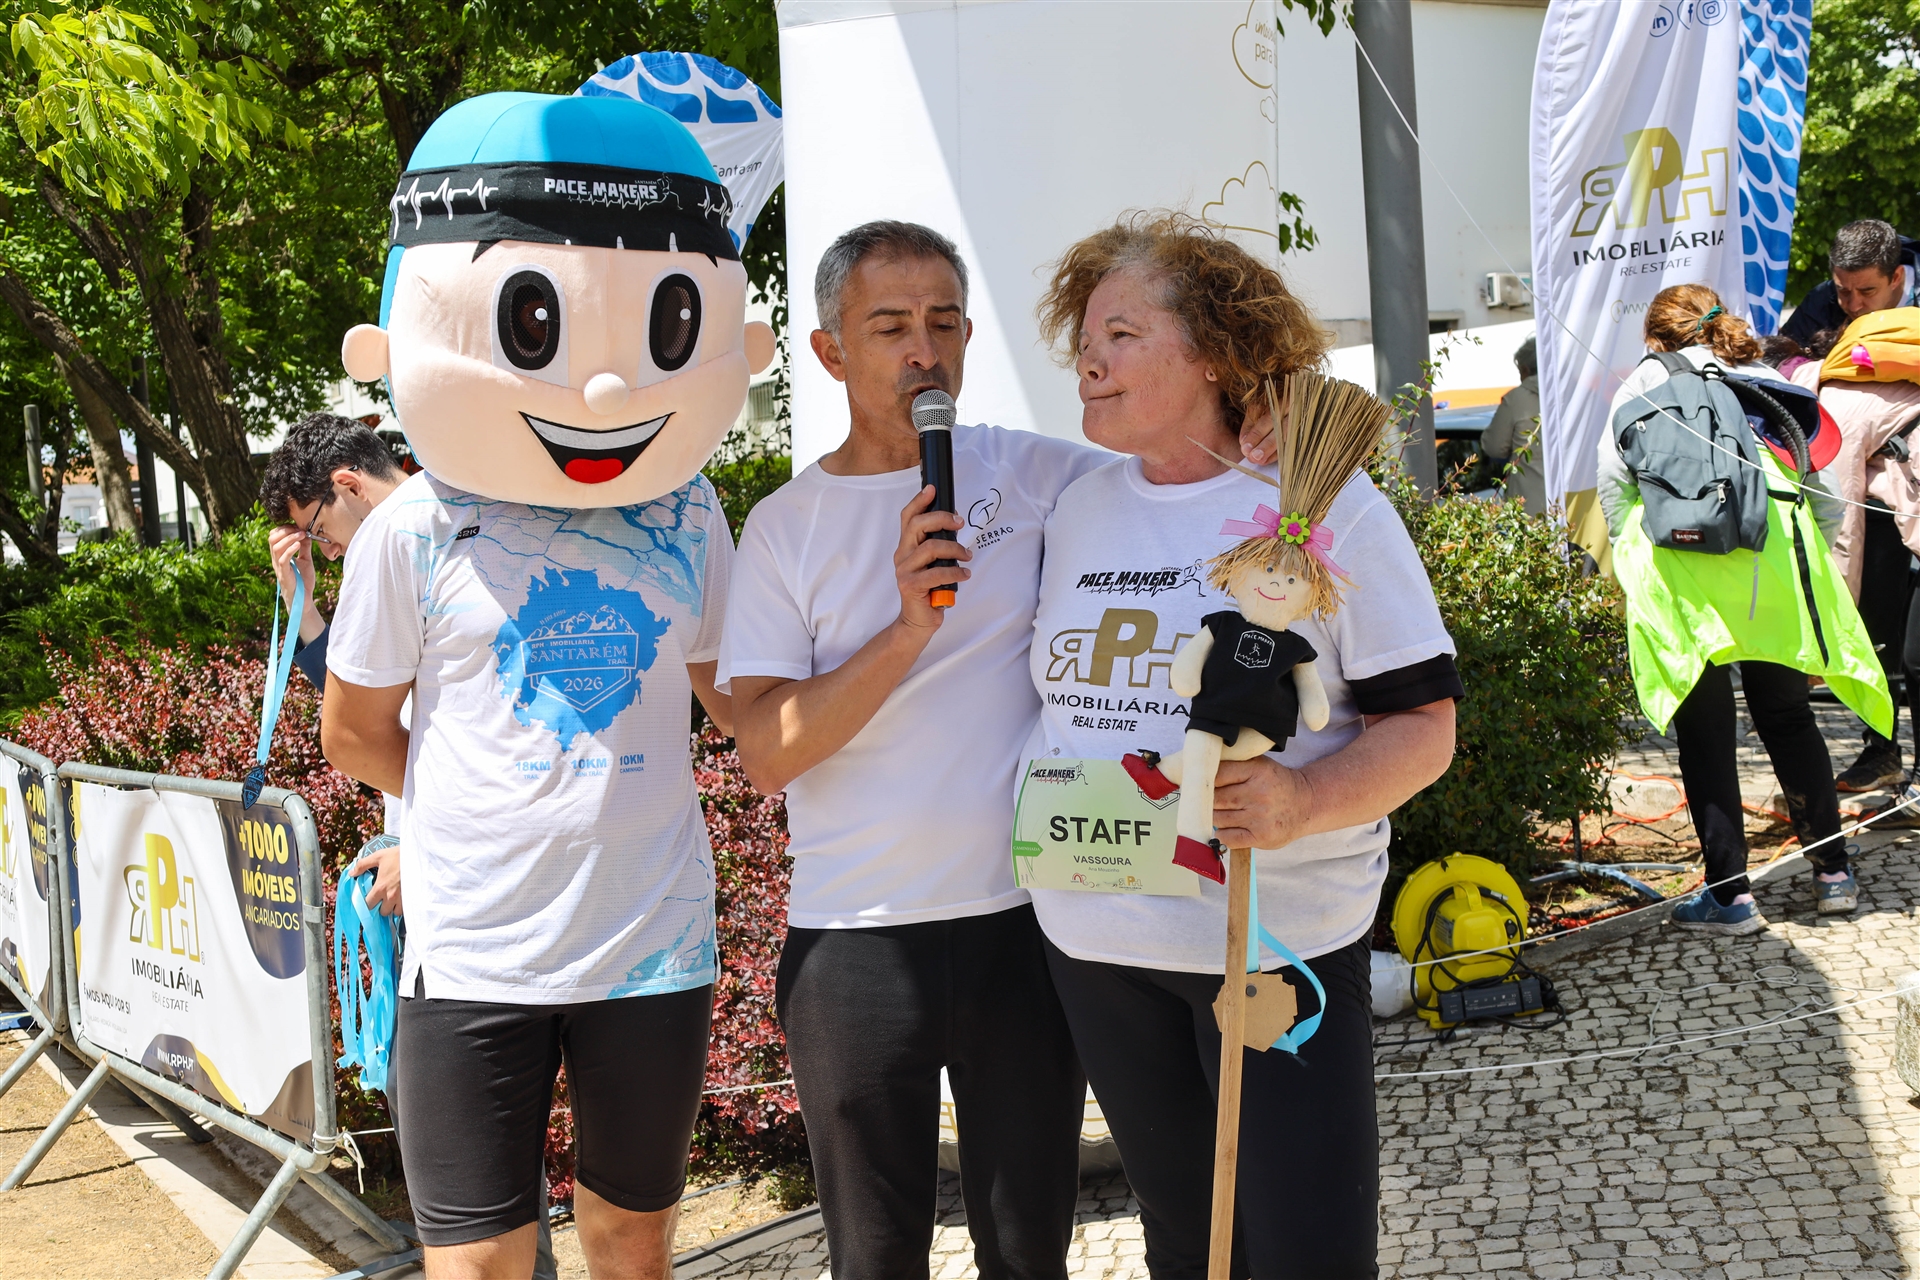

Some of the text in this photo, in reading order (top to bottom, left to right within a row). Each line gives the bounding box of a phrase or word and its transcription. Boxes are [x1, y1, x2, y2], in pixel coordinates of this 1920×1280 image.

[544, 178, 658, 200] PACE MAKERS
[1641, 257, 1692, 274] ESTATE
[1076, 571, 1181, 588] PACE MAKERS
[530, 643, 628, 663] SANTARÉM
[563, 677, 604, 692] 2026
[1047, 693, 1190, 717] IMOBILIÁRIA
[1072, 715, 1138, 732] REAL ESTATE
[515, 760, 551, 771] 18KM
[571, 758, 607, 769] 10KM
[619, 754, 645, 765] 10KM
[1048, 769, 1075, 778] MAKERS
[1050, 815, 1151, 845] STAFF
[239, 820, 289, 865] +1000
[1073, 855, 1132, 866] VASSOURA
[242, 865, 296, 904] IMÓVEIS
[123, 832, 201, 963] RPH
[245, 904, 299, 931] ANGARIADOS
[162, 996, 189, 1013] ESTATE
